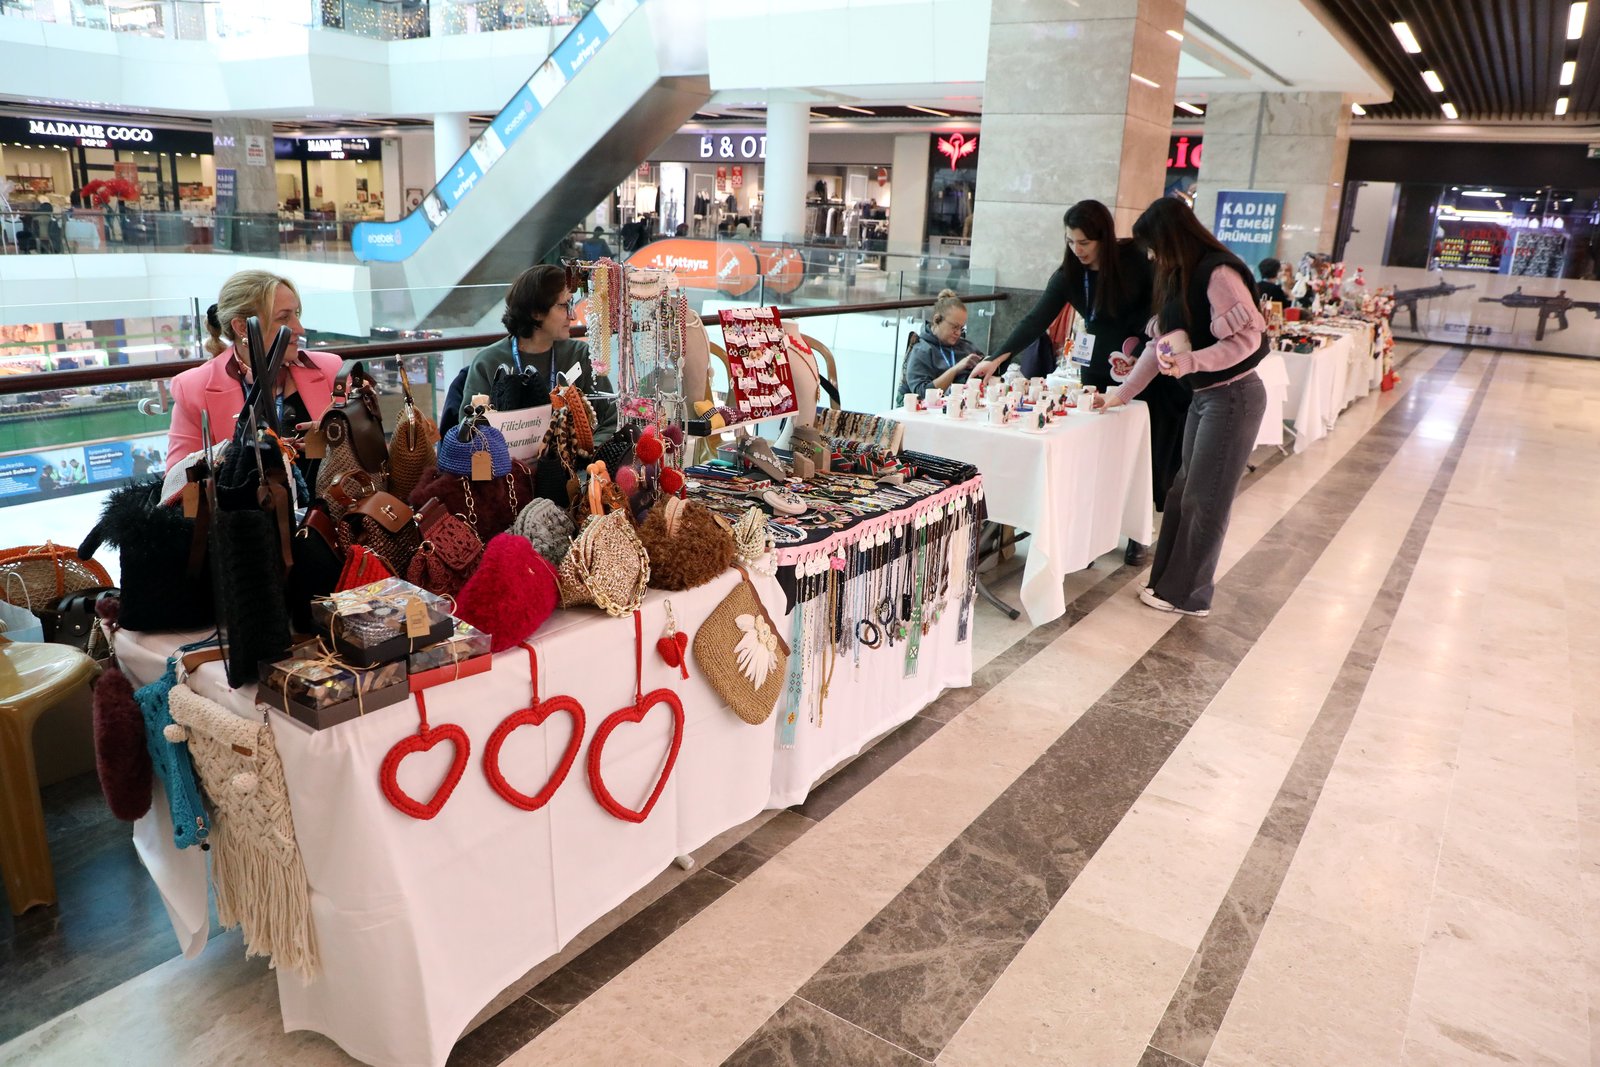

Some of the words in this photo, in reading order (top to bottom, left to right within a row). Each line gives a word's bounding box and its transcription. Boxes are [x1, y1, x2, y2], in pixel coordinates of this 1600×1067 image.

[29, 120, 105, 139] MADAME
[106, 126, 153, 142] COCO
[719, 135, 735, 158] &
[1222, 202, 1277, 216] KADIN
[1219, 218, 1233, 228] EL
[1236, 217, 1274, 230] EMEĞİ
[1217, 230, 1273, 244] ÜRÜNLERİ
[500, 416, 542, 432] Filizlenmiş
